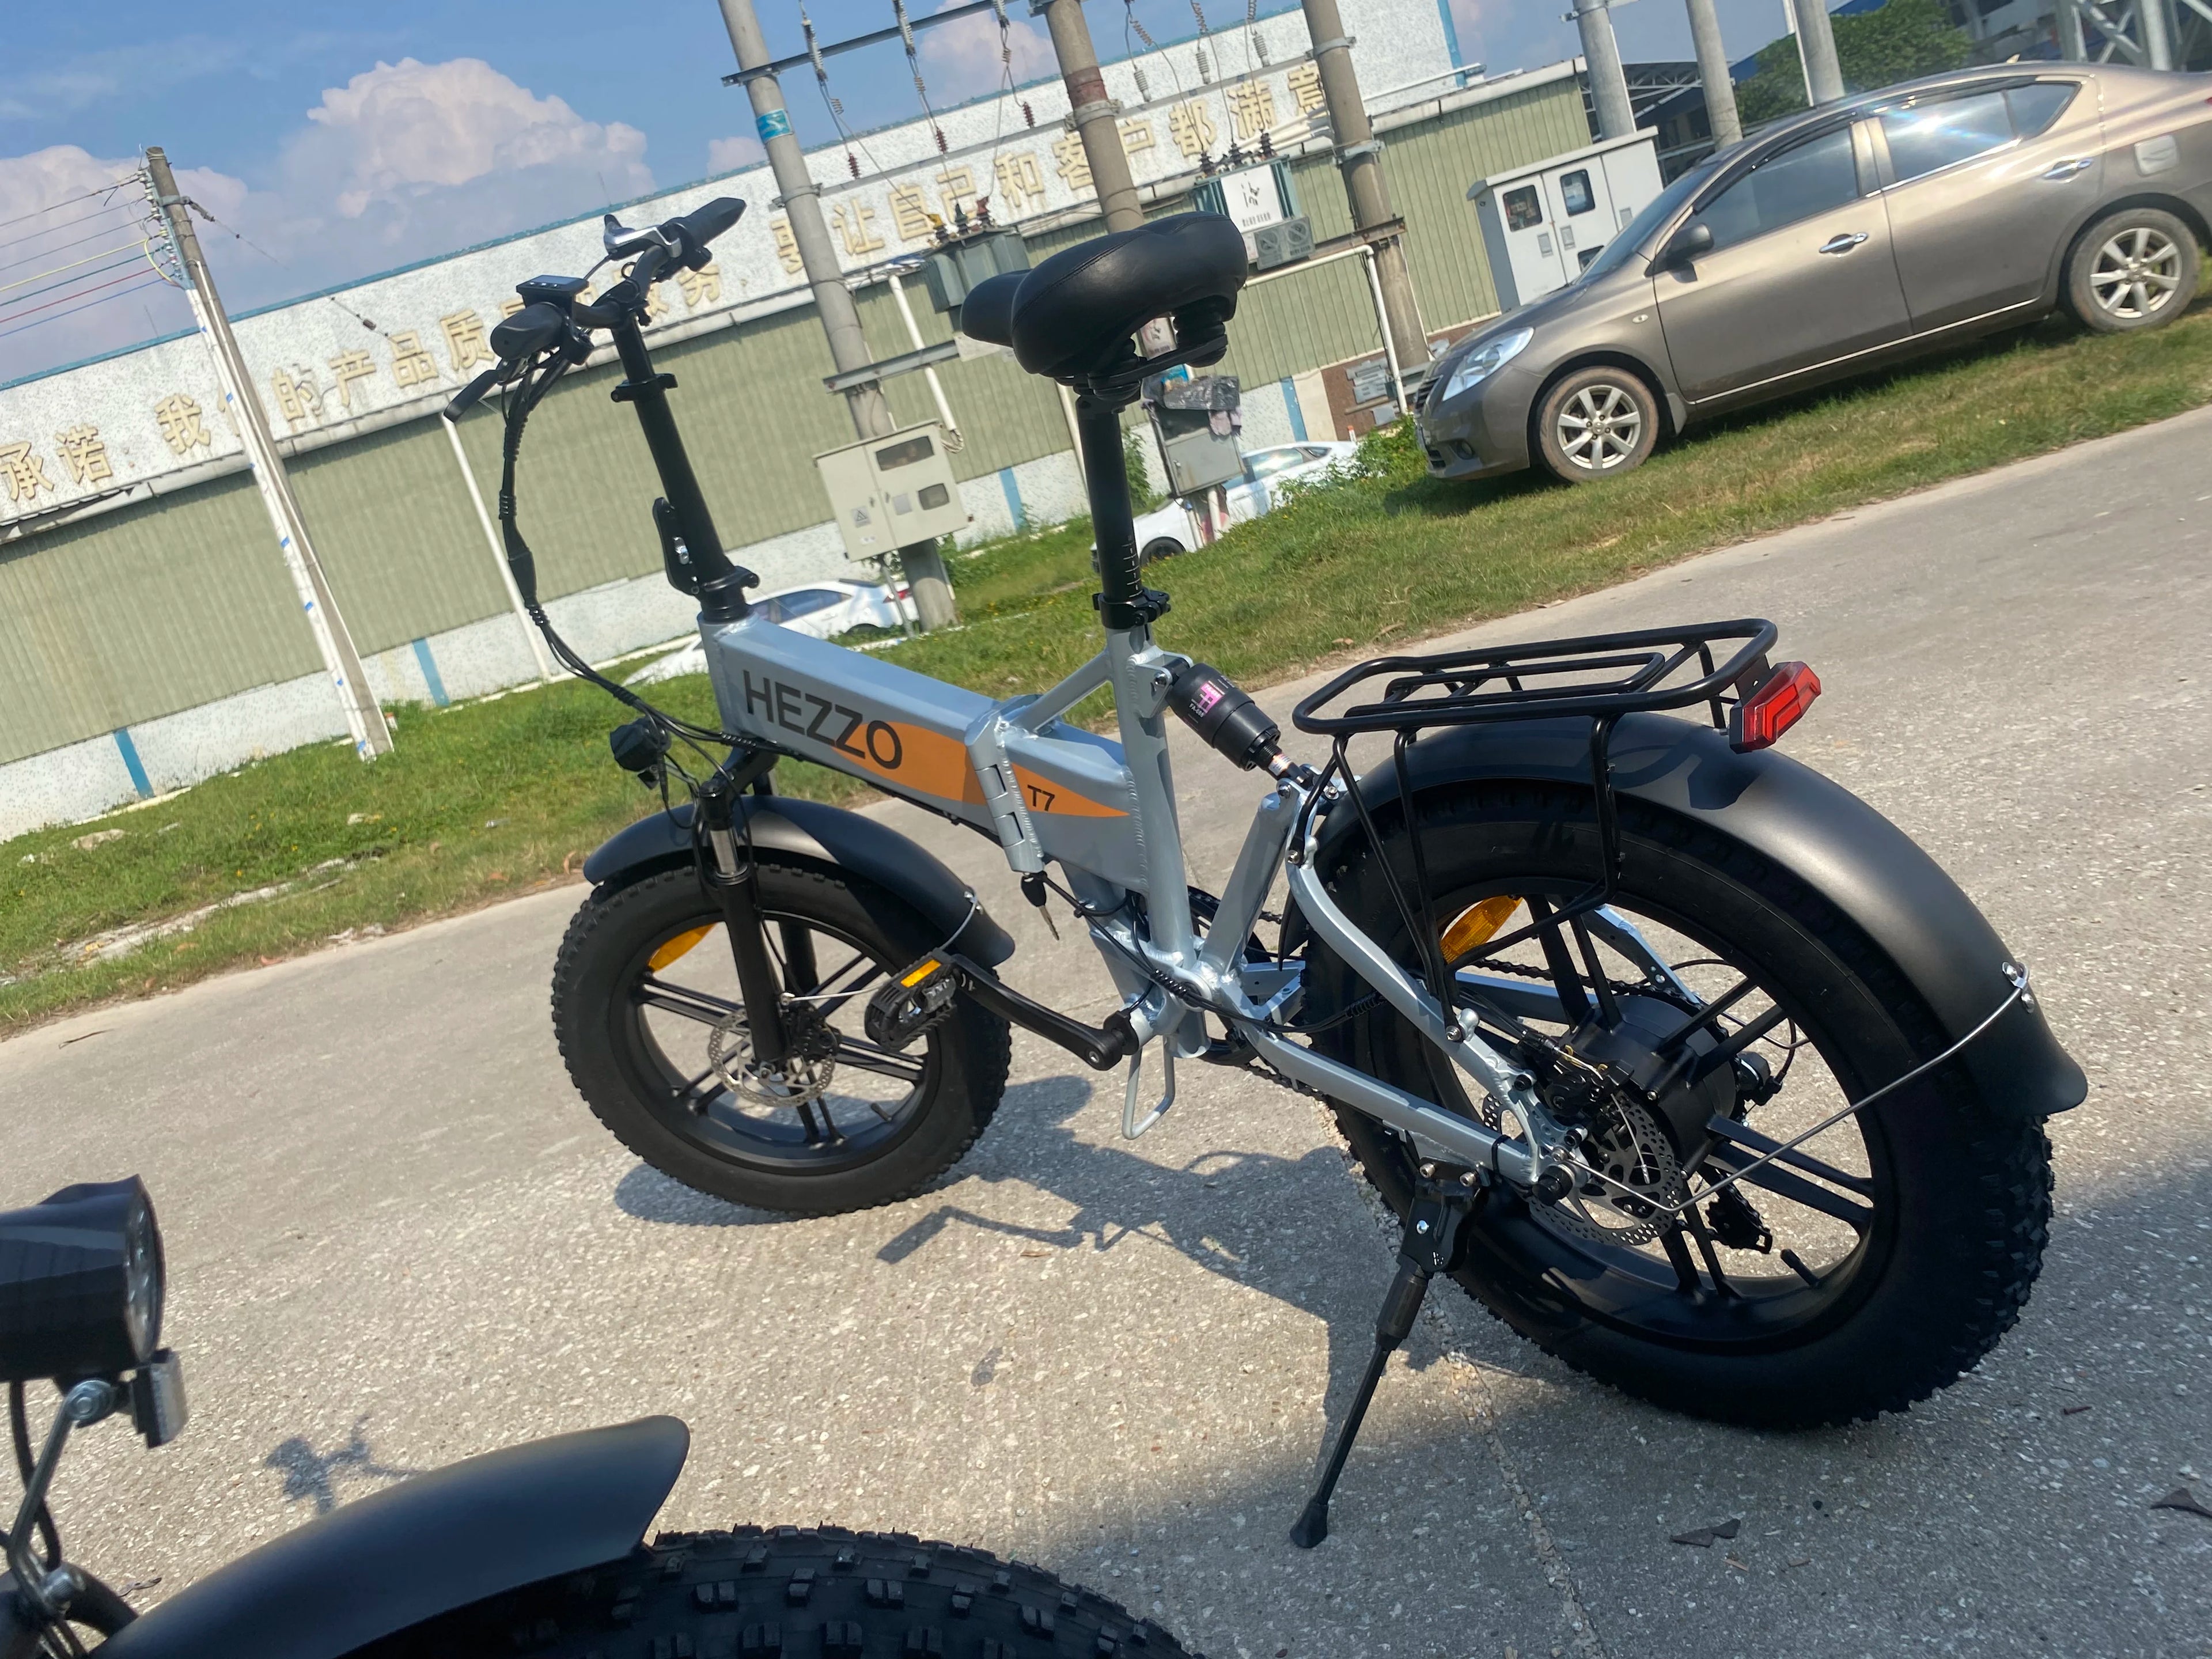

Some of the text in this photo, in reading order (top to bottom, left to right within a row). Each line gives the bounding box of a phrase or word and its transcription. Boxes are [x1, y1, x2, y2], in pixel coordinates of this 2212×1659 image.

[0, 423, 112, 501] 承诺
[743, 670, 903, 770] HEZZO
[1027, 785, 1055, 812] T7
